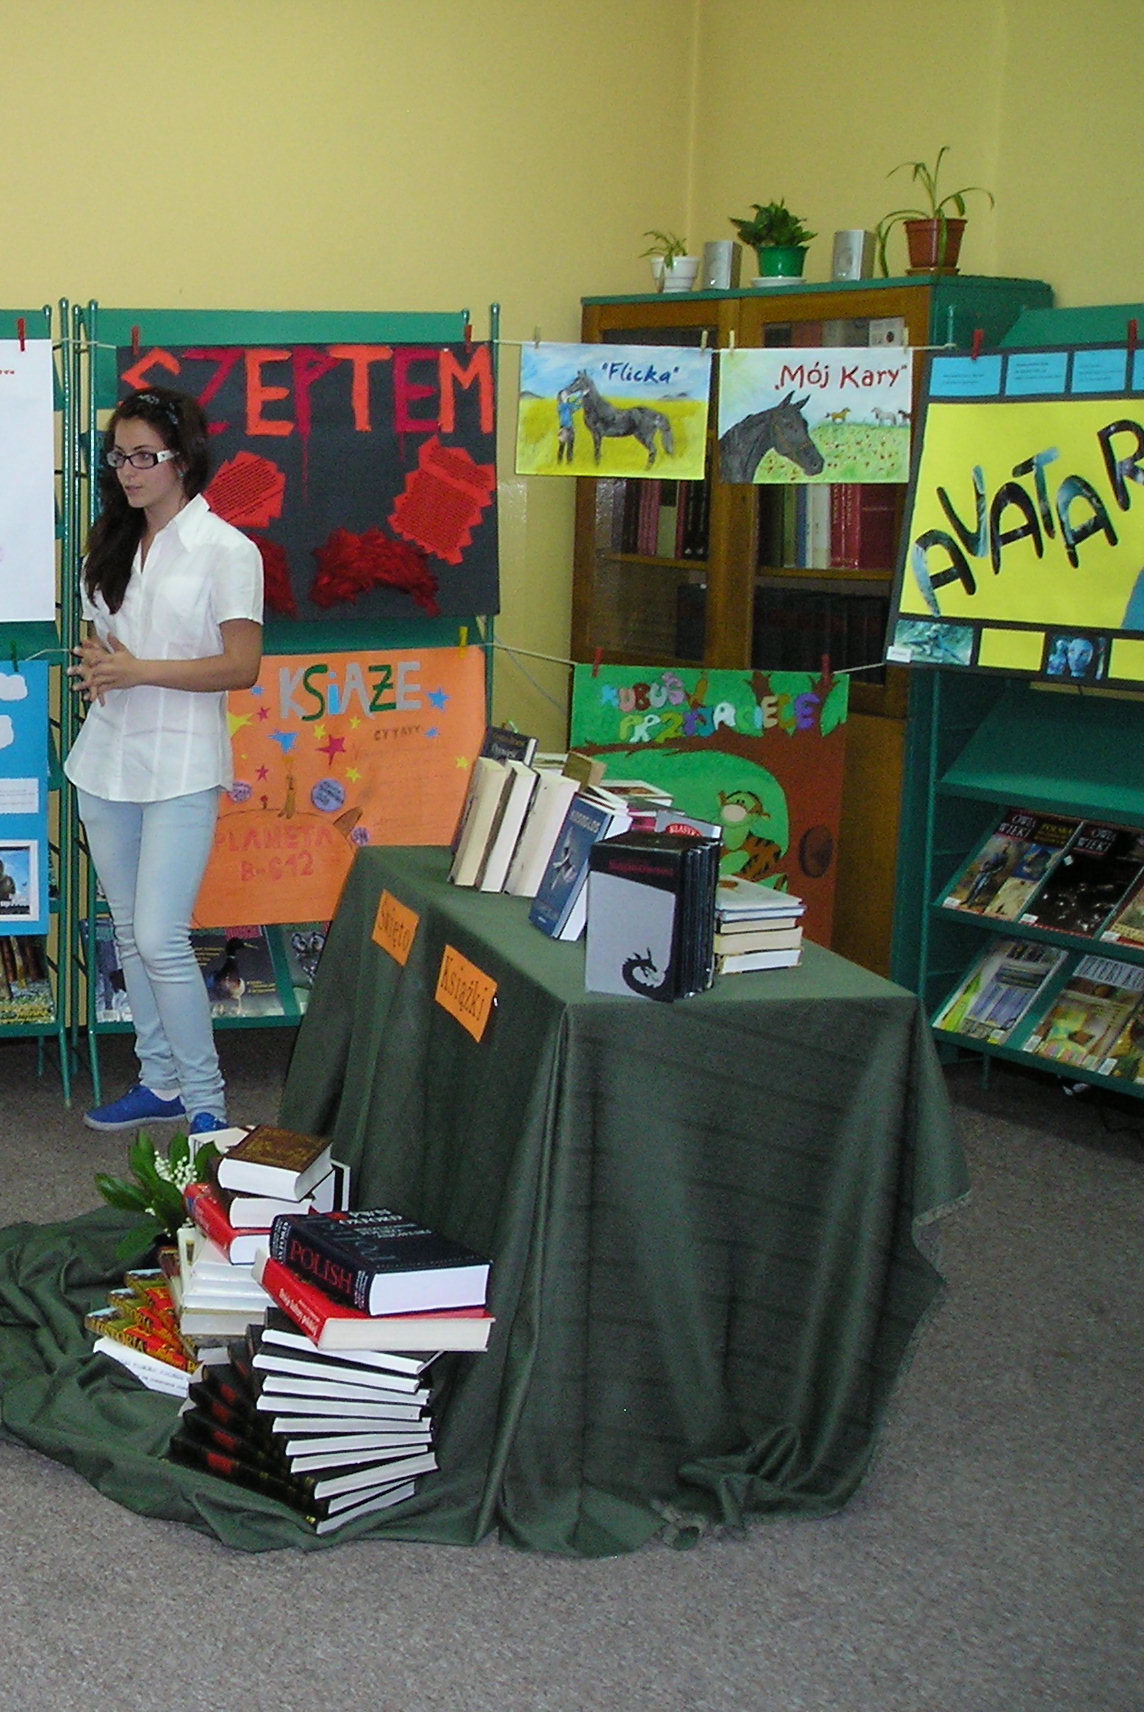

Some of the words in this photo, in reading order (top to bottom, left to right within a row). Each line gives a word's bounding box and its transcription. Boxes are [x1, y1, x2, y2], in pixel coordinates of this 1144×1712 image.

[911, 418, 1144, 618] AVATAR
[215, 824, 334, 852] PLANETA
[440, 954, 489, 1022] Książki
[288, 1239, 353, 1294] POLISH
